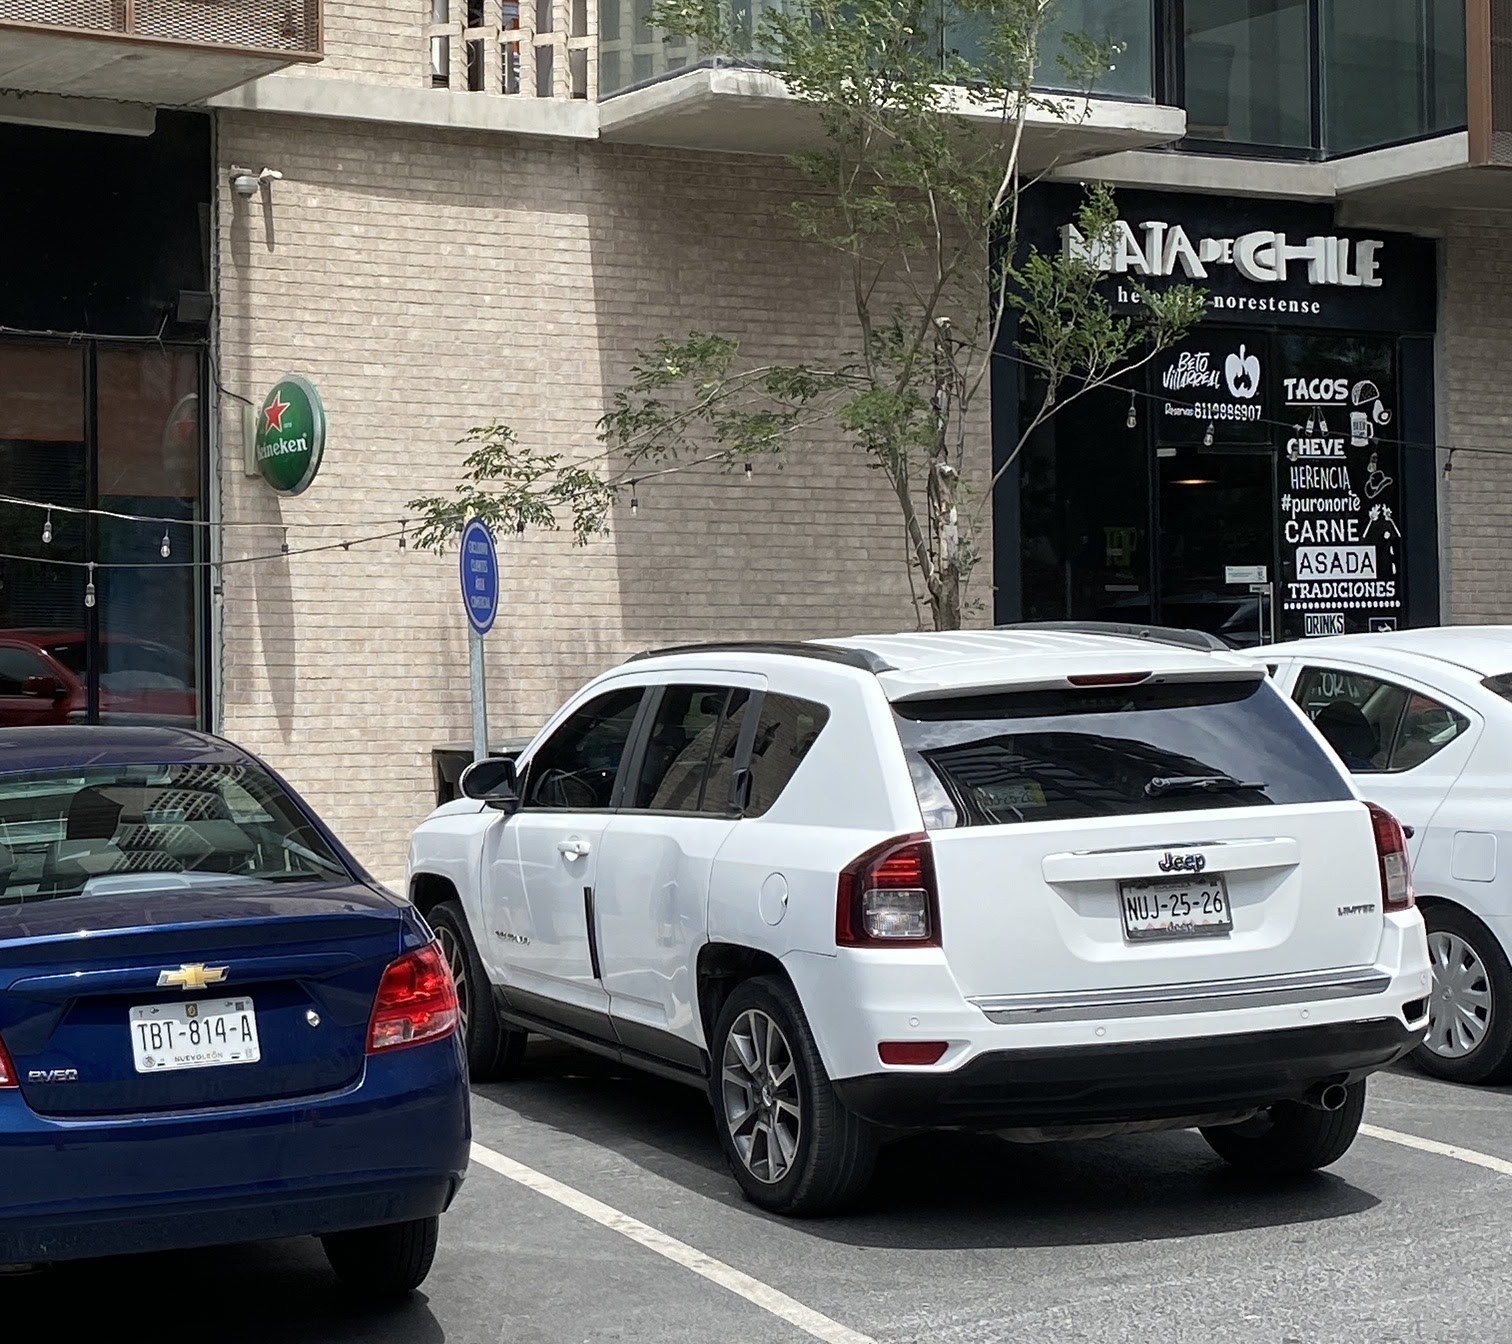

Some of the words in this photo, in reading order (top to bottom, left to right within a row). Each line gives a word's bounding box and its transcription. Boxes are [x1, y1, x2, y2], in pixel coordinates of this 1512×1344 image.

[1233, 230, 1384, 287] CHILE
[1214, 296, 1320, 314] norestense
[1283, 378, 1349, 400] TACOS
[1287, 438, 1345, 455] CHEVE
[1290, 465, 1352, 490] HERENCIA
[1284, 519, 1359, 543] CARNE
[1299, 551, 1374, 574] ASADA
[1288, 581, 1395, 598] TRADICIONES
[1307, 615, 1345, 635] DRINKS
[1158, 852, 1206, 873] Jeep
[1127, 890, 1223, 921] NUJ-25-26
[137, 1014, 252, 1051] TBT-814-A
